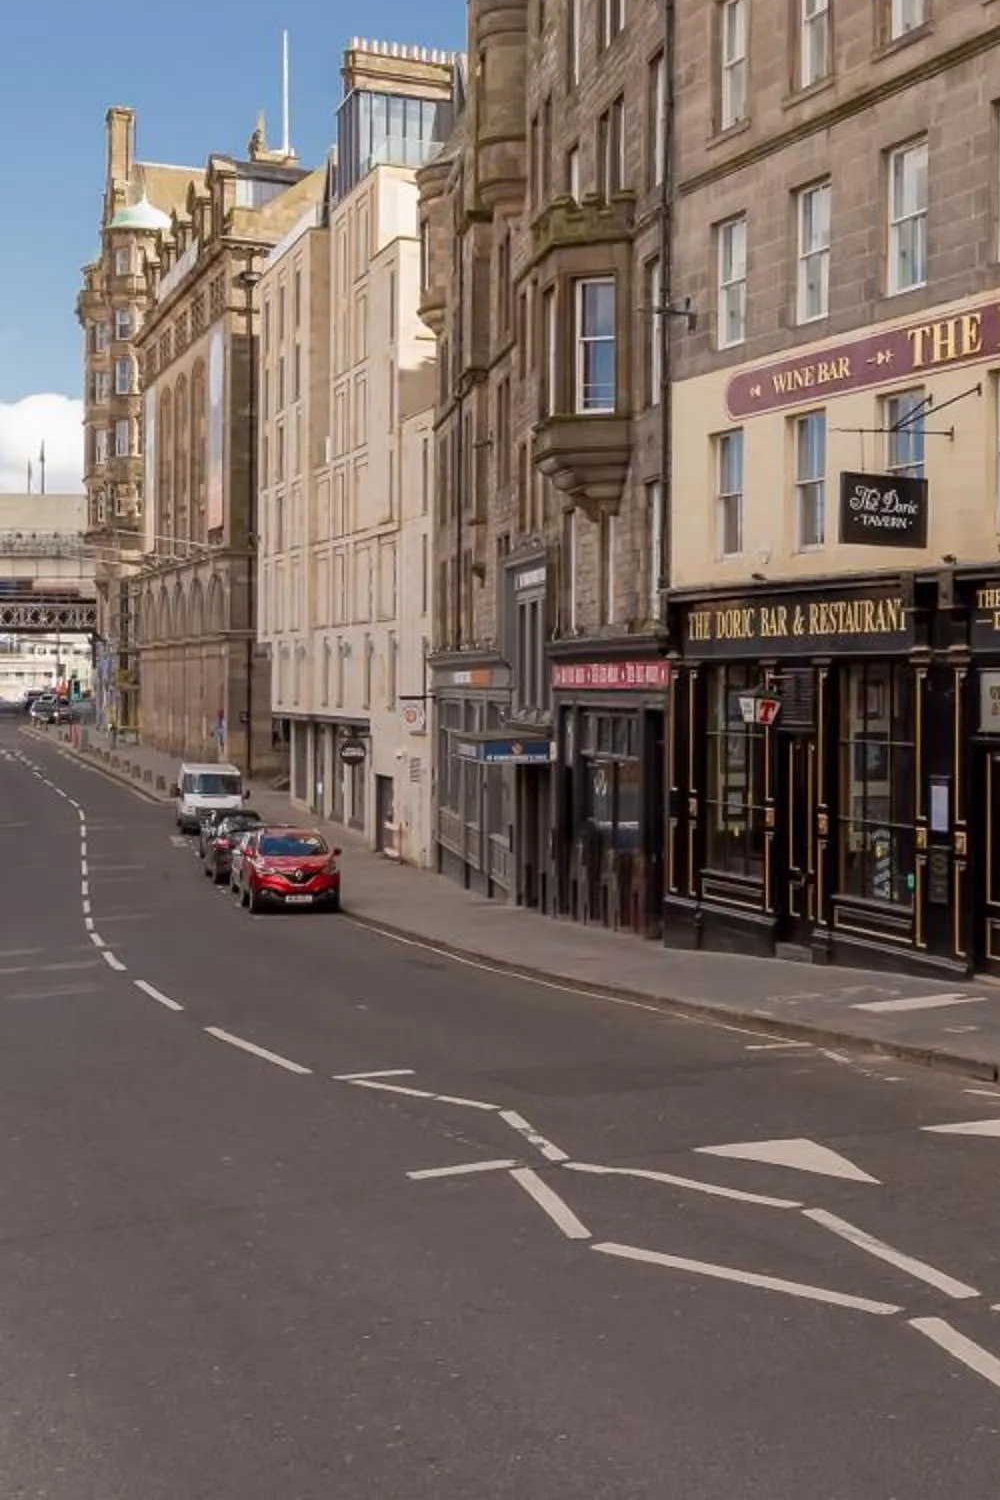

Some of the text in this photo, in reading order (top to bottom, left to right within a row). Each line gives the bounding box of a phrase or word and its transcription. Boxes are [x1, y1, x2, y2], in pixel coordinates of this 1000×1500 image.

[772, 366, 814, 393] WINE
[816, 356, 851, 383] BAR
[908, 314, 983, 368] THE
[688, 598, 907, 640] THE DORIC BAR & RESTAURANT
